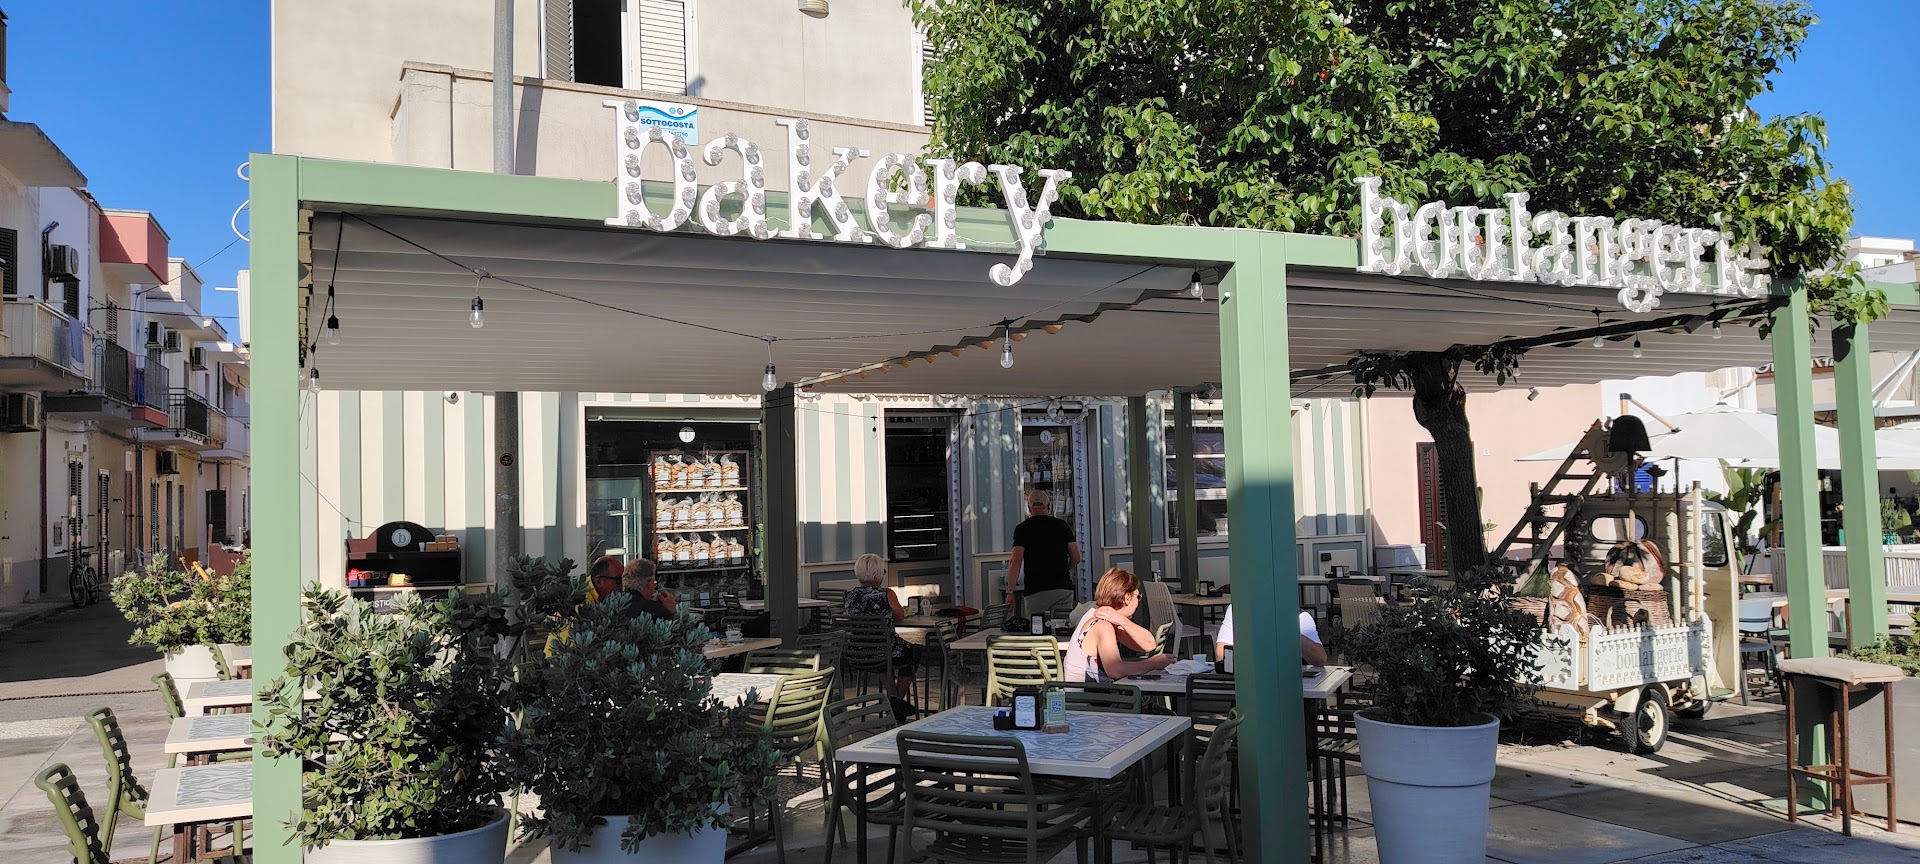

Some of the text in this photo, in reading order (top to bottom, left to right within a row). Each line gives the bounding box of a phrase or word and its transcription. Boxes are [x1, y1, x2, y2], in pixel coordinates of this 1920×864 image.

[640, 118, 694, 129] SOTTOCOSTA
[603, 100, 1072, 286] bakery
[1353, 176, 1771, 313] boulangerie
[1043, 433, 1048, 441] b
[397, 532, 406, 543] b
[1616, 644, 1684, 672] boulangerie
